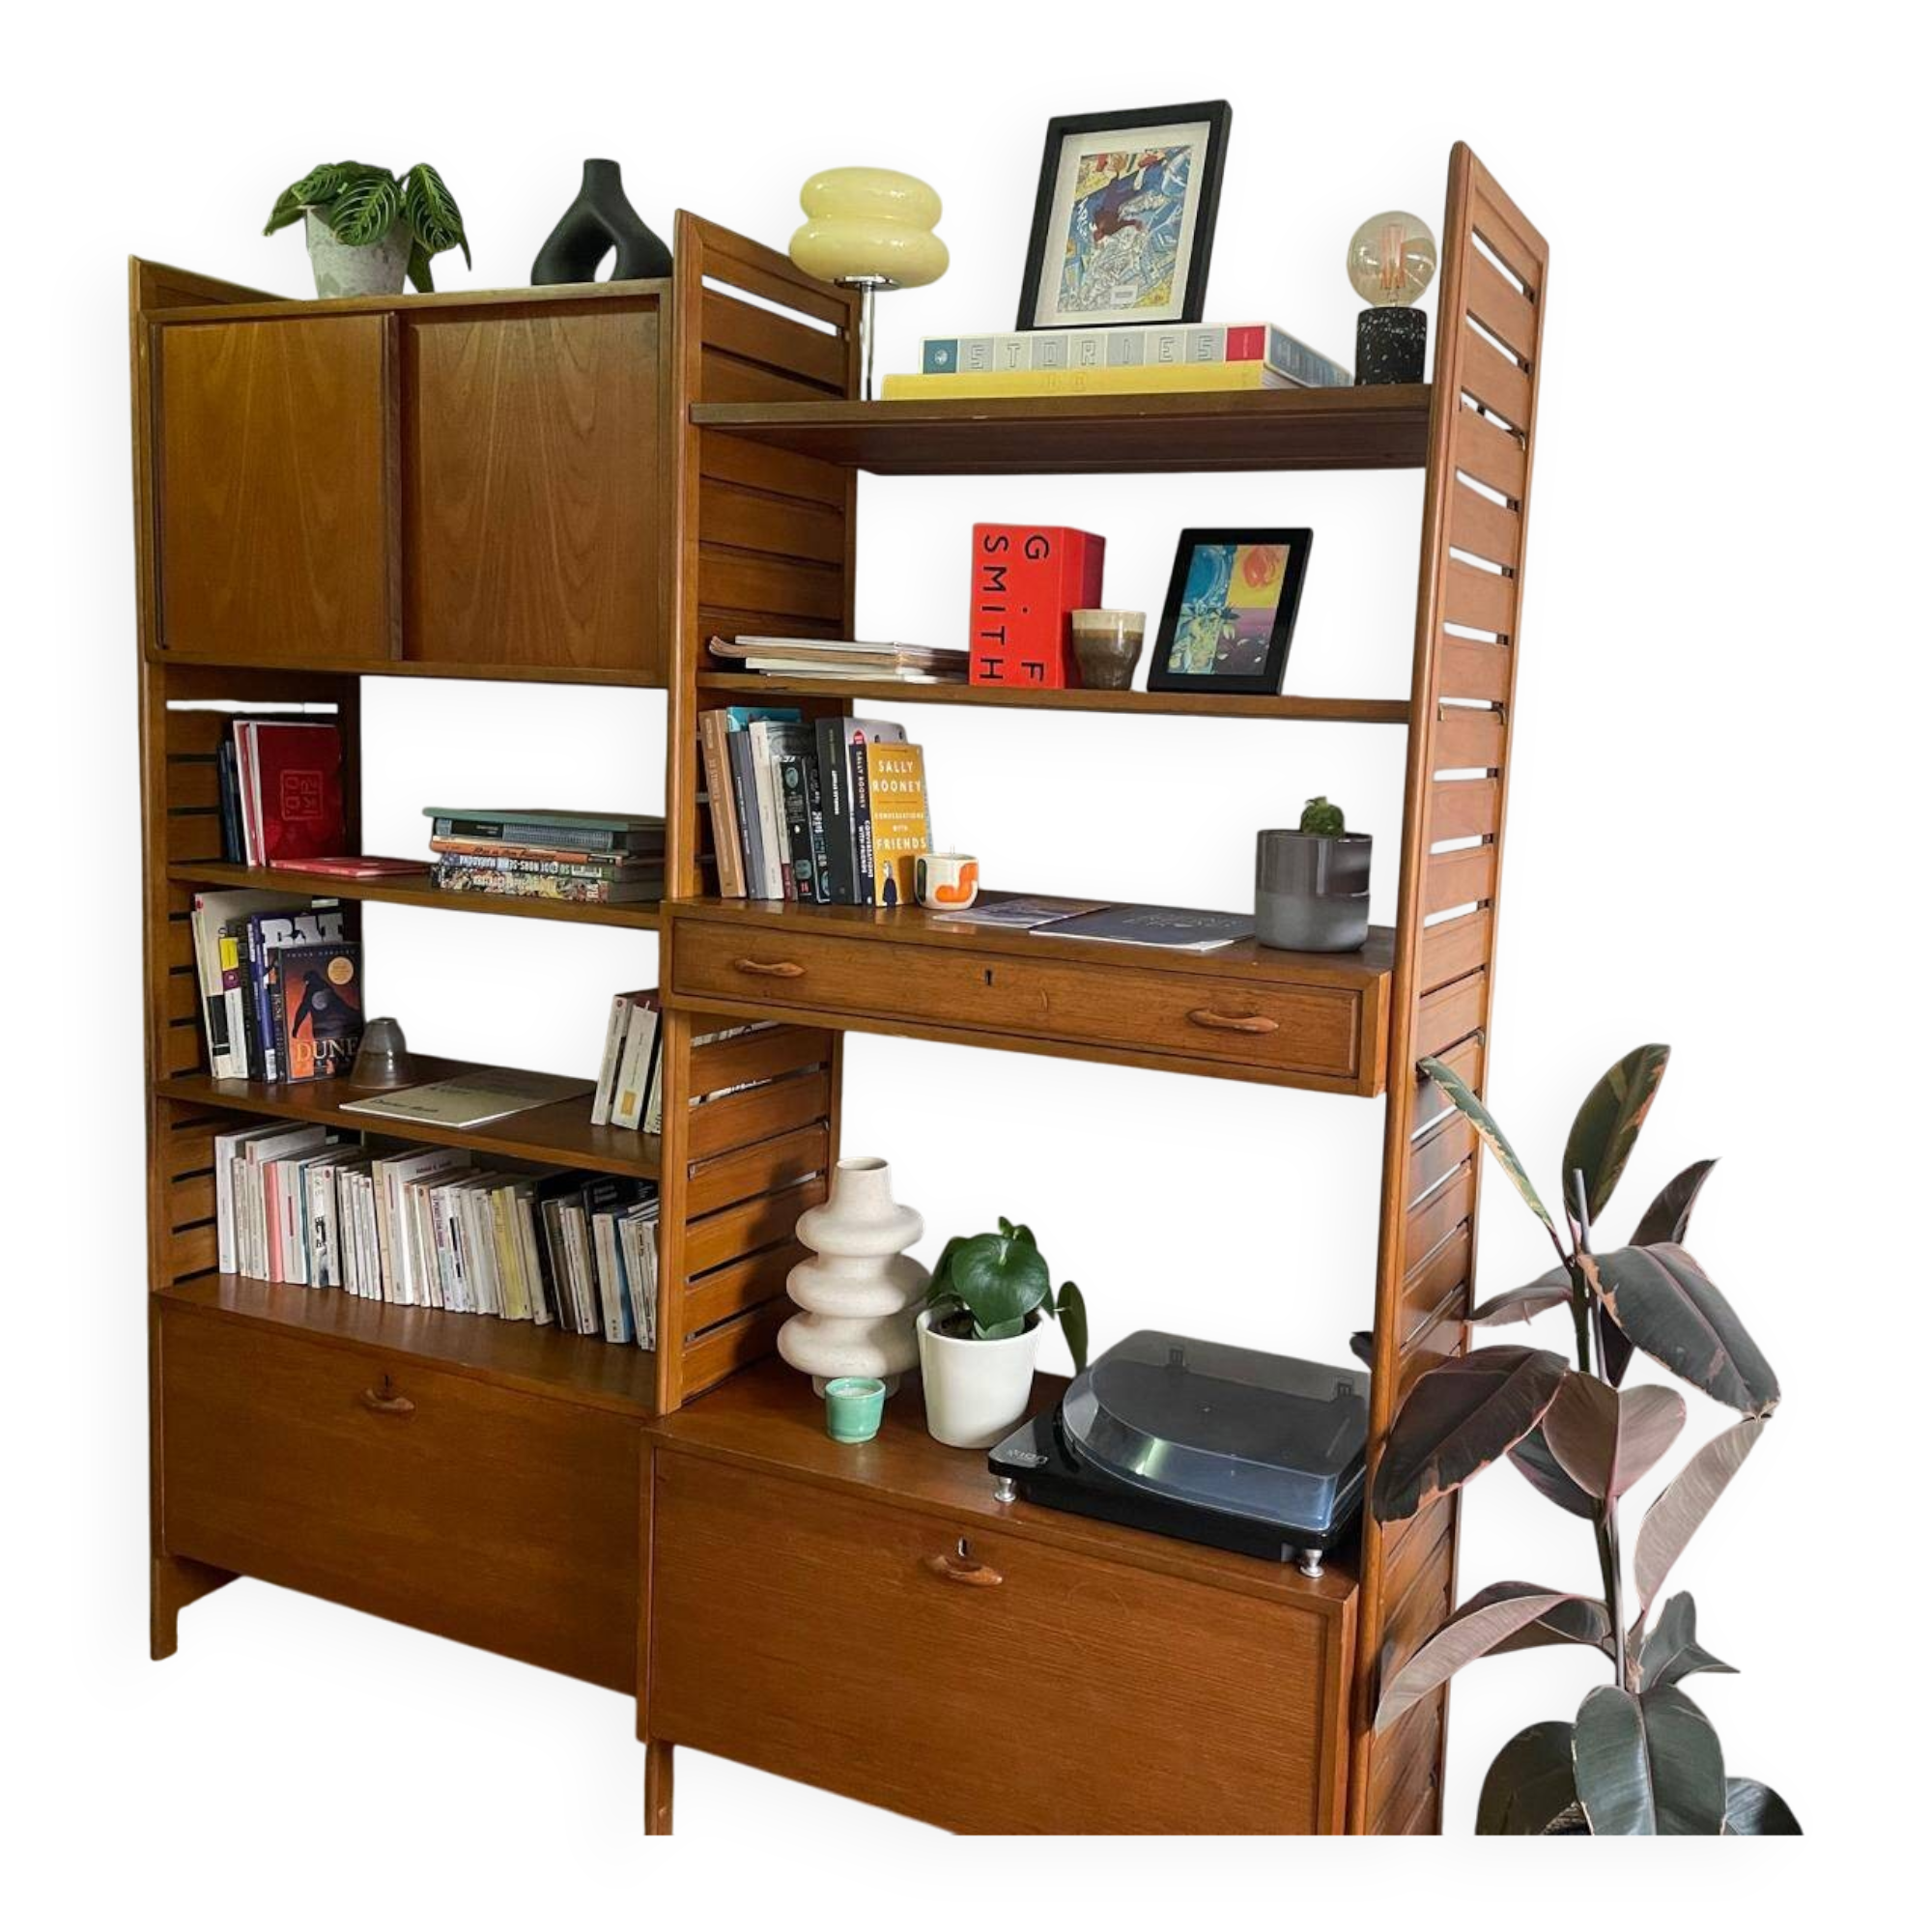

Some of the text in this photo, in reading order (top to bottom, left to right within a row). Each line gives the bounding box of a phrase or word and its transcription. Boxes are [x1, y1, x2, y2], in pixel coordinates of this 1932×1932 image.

[970, 334, 1214, 370] STORIES
[980, 534, 1009, 679] SMITH
[878, 759, 914, 774] SALLY
[872, 779, 922, 793] ROONEY
[876, 836, 928, 851] FRIENDS
[296, 1037, 357, 1062] DUNE
